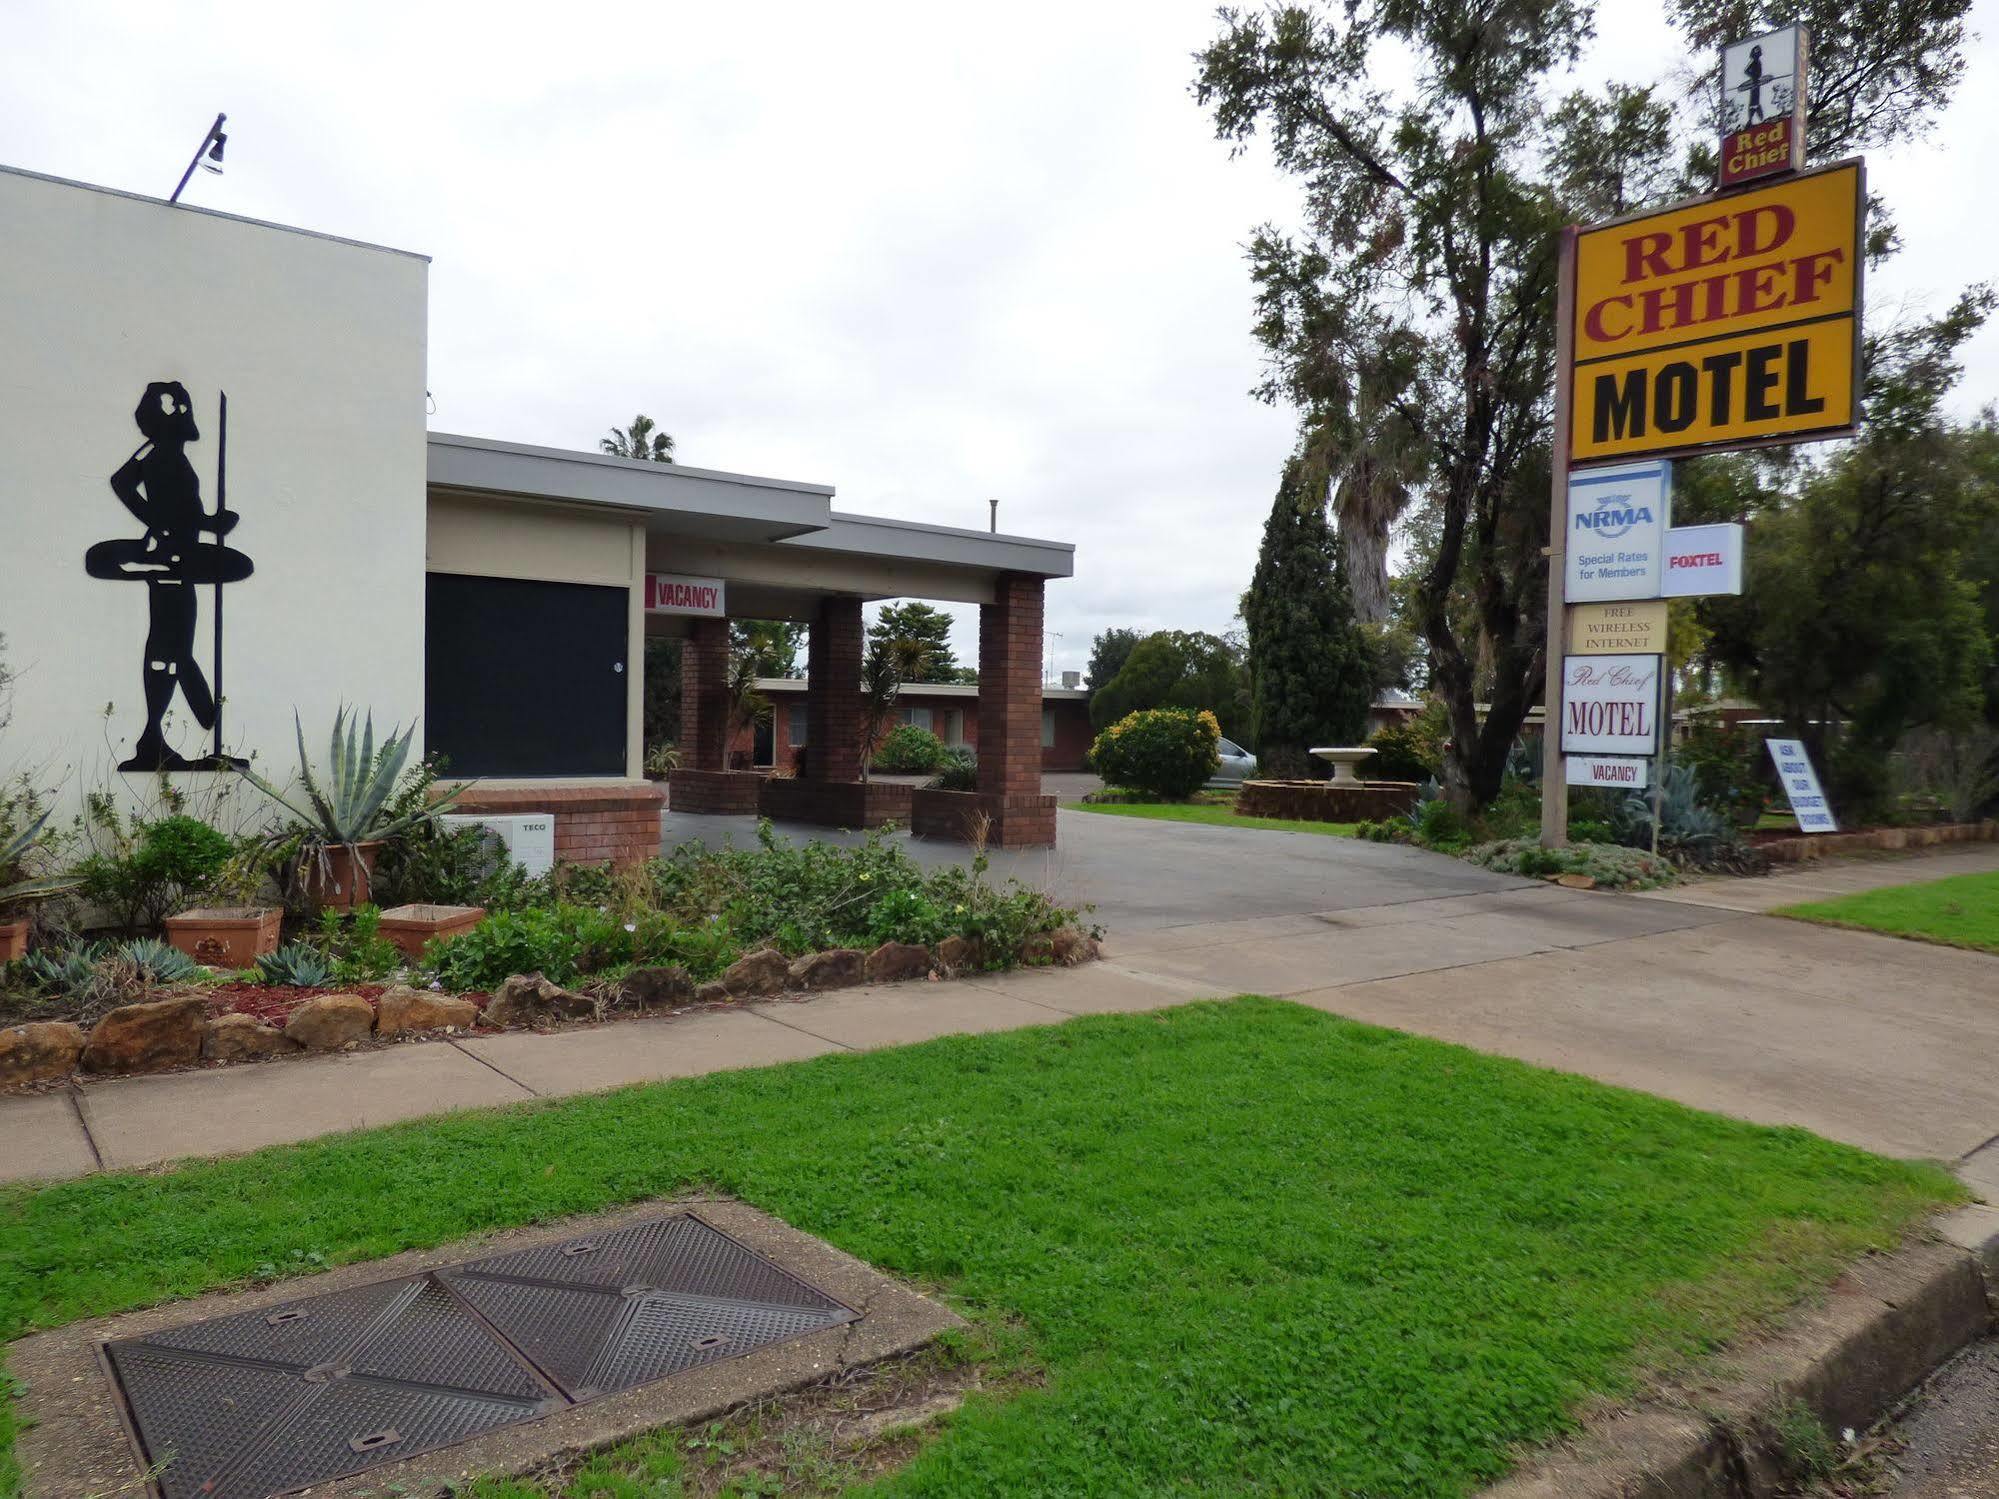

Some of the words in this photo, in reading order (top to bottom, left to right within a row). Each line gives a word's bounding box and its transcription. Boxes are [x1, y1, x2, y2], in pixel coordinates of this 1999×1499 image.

[1737, 122, 1784, 152] Red
[1728, 142, 1789, 174] Chief
[1620, 204, 1795, 285] RED
[1584, 247, 1844, 342] CHIEF
[1592, 339, 1825, 444] MOTEL
[1575, 507, 1653, 530] NRMA
[1579, 554, 1614, 567] Special
[1618, 552, 1648, 562] Rates
[1669, 553, 1722, 569] FOXTEL
[1580, 569, 1595, 579] for
[1599, 568, 1646, 579] Members
[658, 583, 718, 609] VACANCY
[1604, 607, 1634, 618] FREE
[1586, 622, 1650, 633] WIRELESS
[1585, 638, 1649, 648] INTERNET
[1568, 665, 1607, 686] Red
[1608, 665, 1654, 692] Chief
[1568, 701, 1650, 736] MOTEL
[1593, 765, 1637, 782] VACANCY
